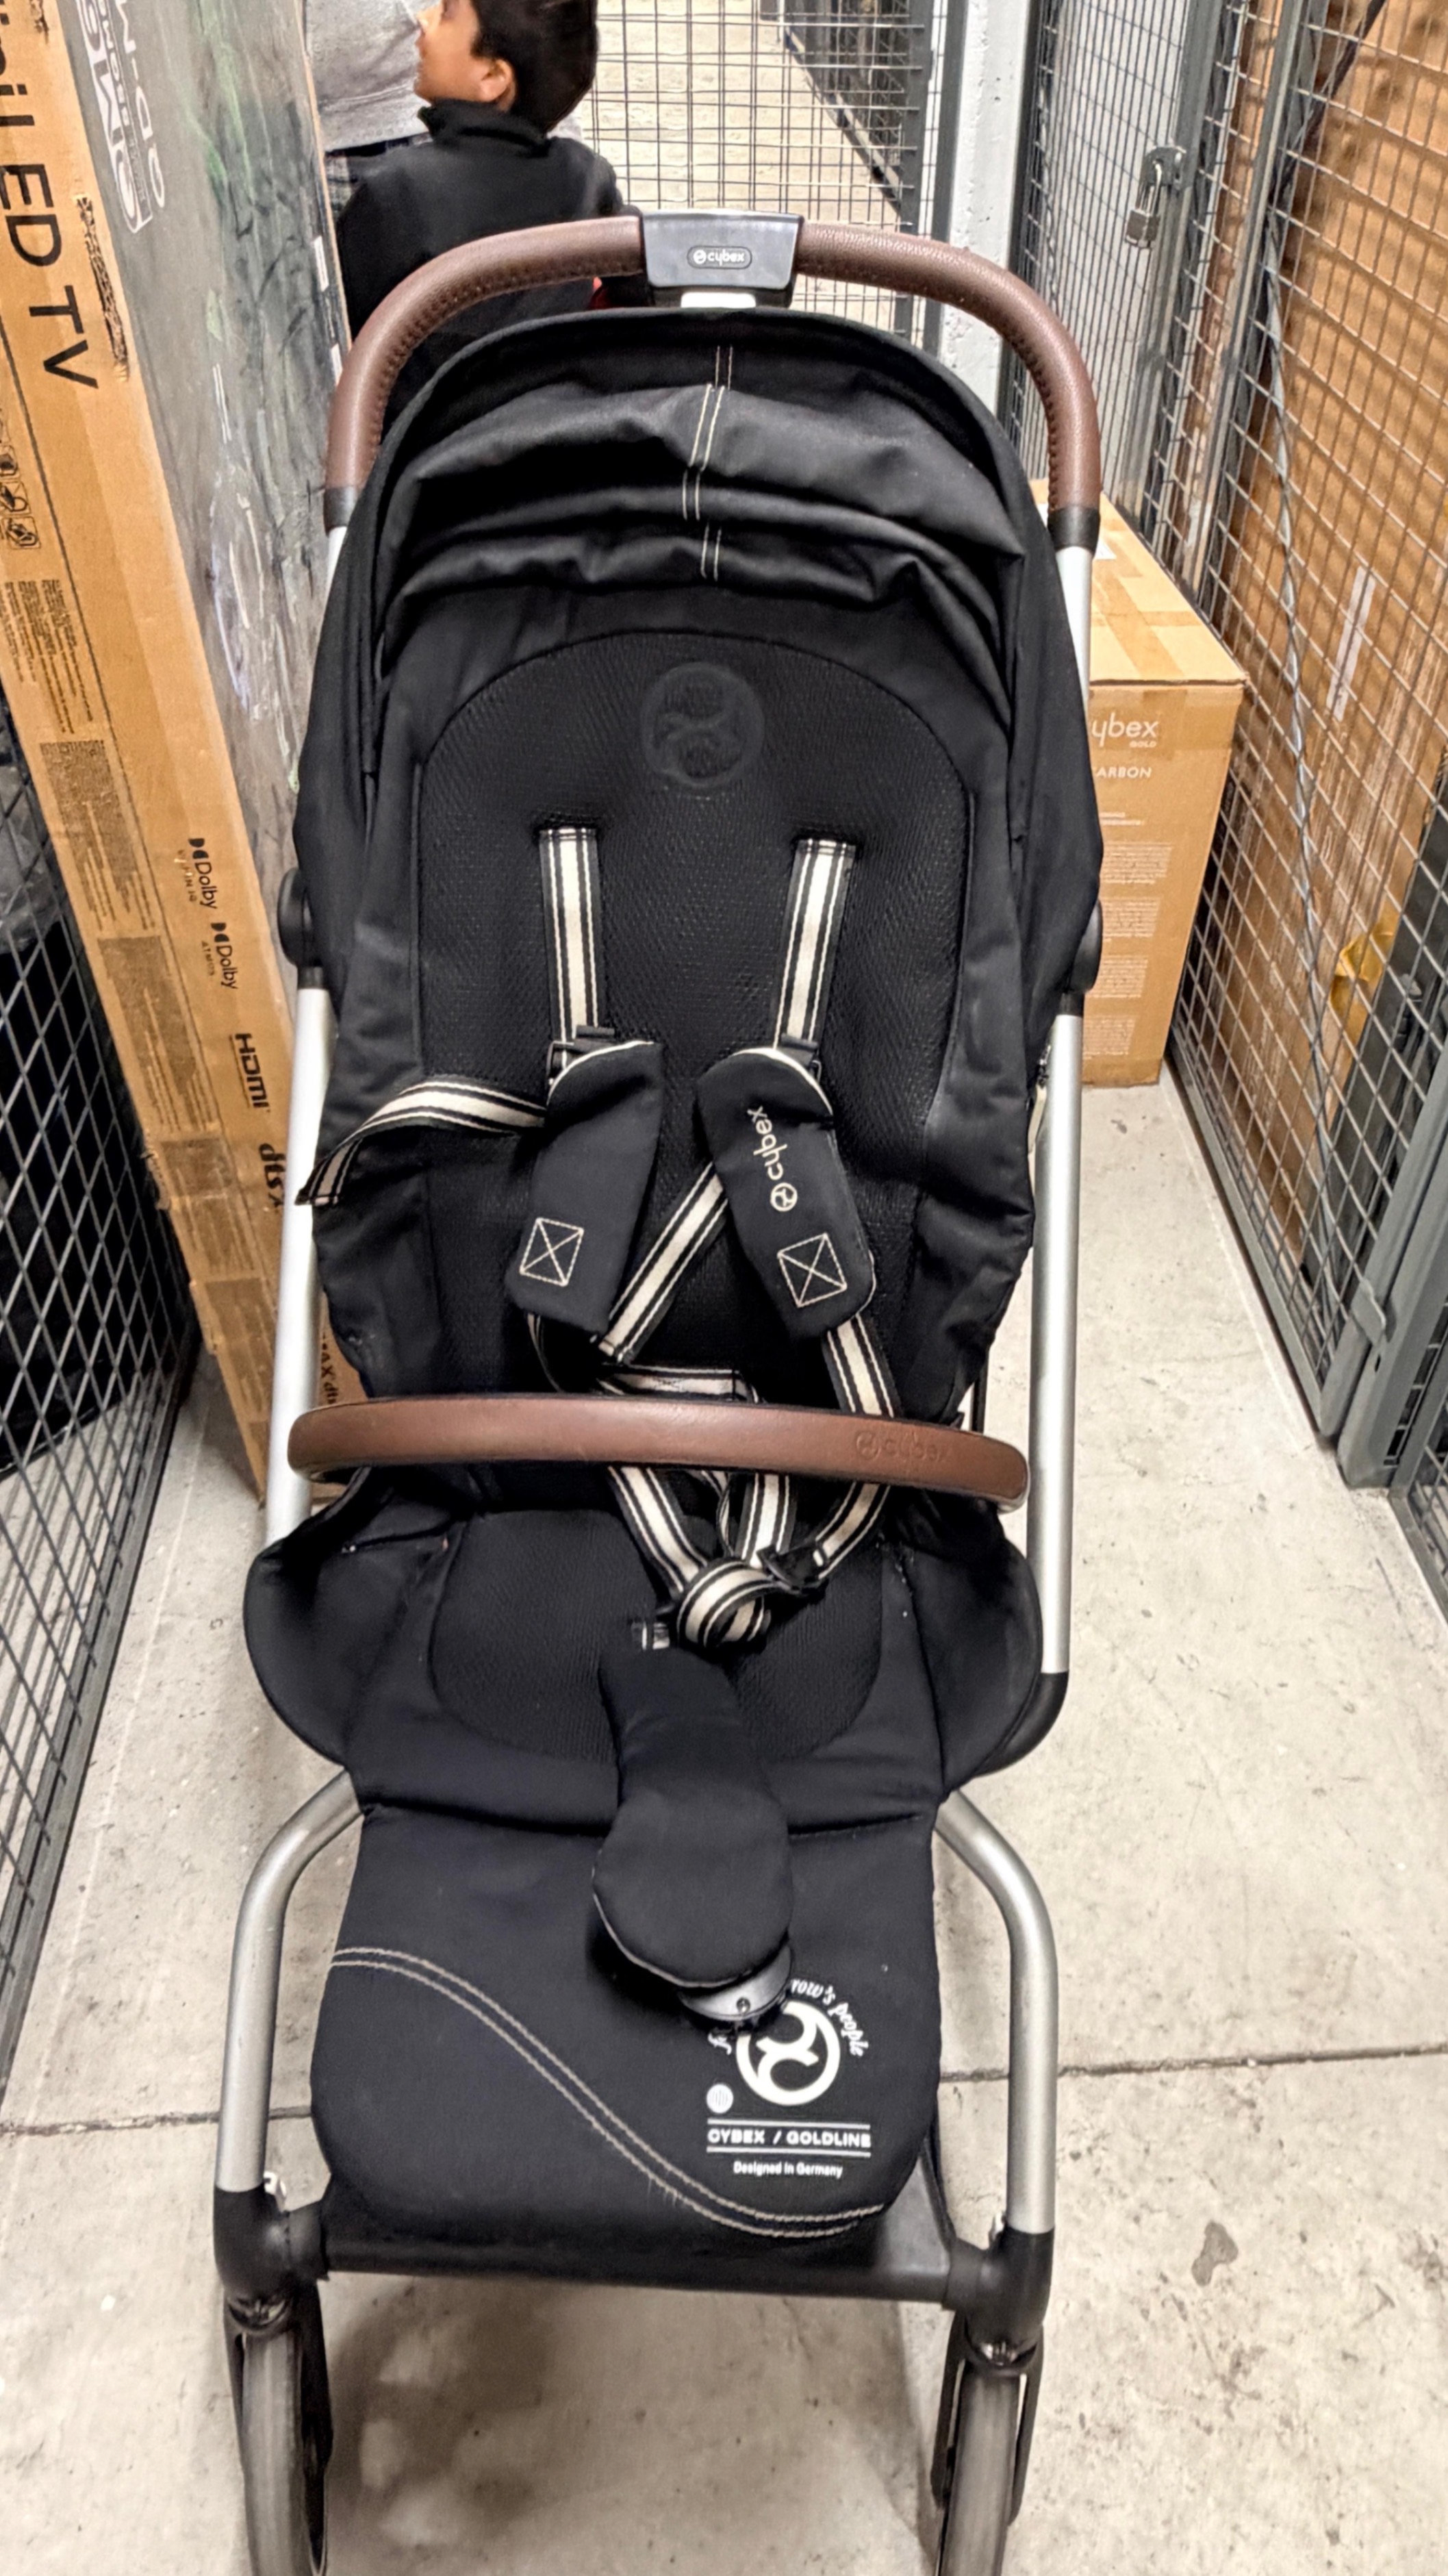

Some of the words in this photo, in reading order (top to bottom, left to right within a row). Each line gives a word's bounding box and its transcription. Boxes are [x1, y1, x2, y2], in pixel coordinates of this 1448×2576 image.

[707, 249, 745, 266] cybex
[29, 285, 99, 390] TV
[1091, 712, 1159, 747] ybex
[1130, 740, 1157, 748] GOLD
[1094, 766, 1152, 779] ARBON
[194, 861, 218, 909] Dolby
[217, 945, 238, 990] Dolby
[235, 1033, 270, 1109] HDMI
[748, 1106, 788, 1180] cybex
[827, 2002, 869, 2056] people
[707, 2129, 765, 2145] CYBEX
[772, 2130, 782, 2145] /
[787, 2131, 872, 2148] GOLDLINE
[733, 2160, 782, 2174] Designed
[796, 2162, 843, 2179] Germany
